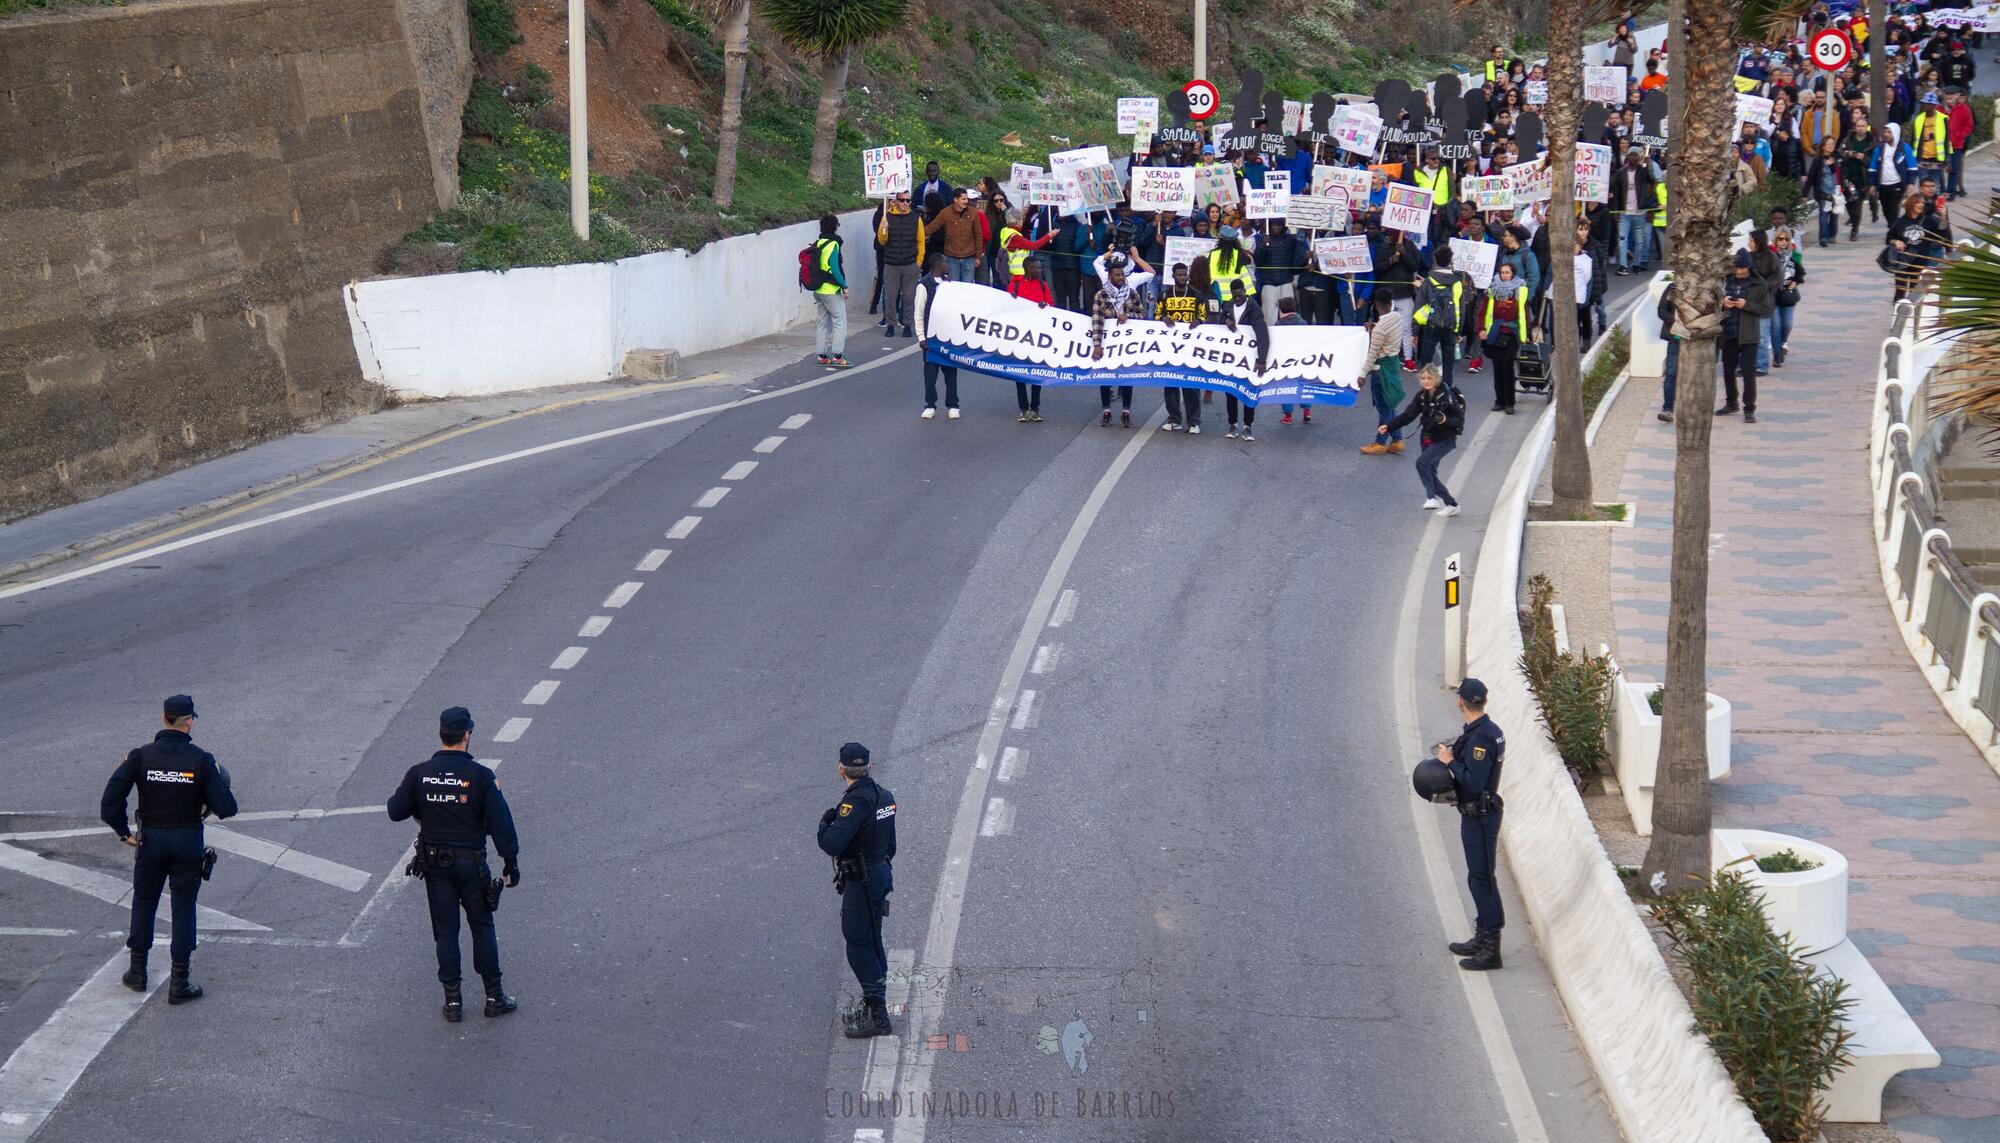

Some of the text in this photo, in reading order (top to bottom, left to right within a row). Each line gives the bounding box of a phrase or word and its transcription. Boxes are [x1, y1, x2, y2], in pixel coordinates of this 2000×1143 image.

[1820, 43, 1842, 56] 30
[1189, 93, 1210, 106] 30
[1161, 128, 1199, 142] SAMBA
[1261, 132, 1286, 145] ROGER
[1312, 131, 1328, 143] LUC
[865, 146, 904, 163] ABRID
[1439, 144, 1472, 159] KEITA
[1576, 148, 1609, 164] ASTA
[867, 163, 885, 177] LAS
[1145, 170, 1181, 179] VERDAD
[1576, 163, 1601, 177] ORTI
[1142, 180, 1184, 191] JUSTICIA
[1575, 181, 1598, 198] ARE
[1390, 206, 1421, 226] MATA
[960, 313, 1058, 354] VERDAD,
[1064, 340, 1161, 358] JUTICIA
[1171, 341, 1185, 354] Y
[1051, 316, 1073, 332] 10
[1146, 328, 1258, 349] exigiendo
[940, 346, 950, 355] Por
[1448, 560, 1457, 572] 4
[146, 770, 184, 778] POLICIA
[146, 775, 194, 784] NACIONAL
[422, 777, 463, 787] POLICIA
[426, 793, 459, 803] U.I.P.
